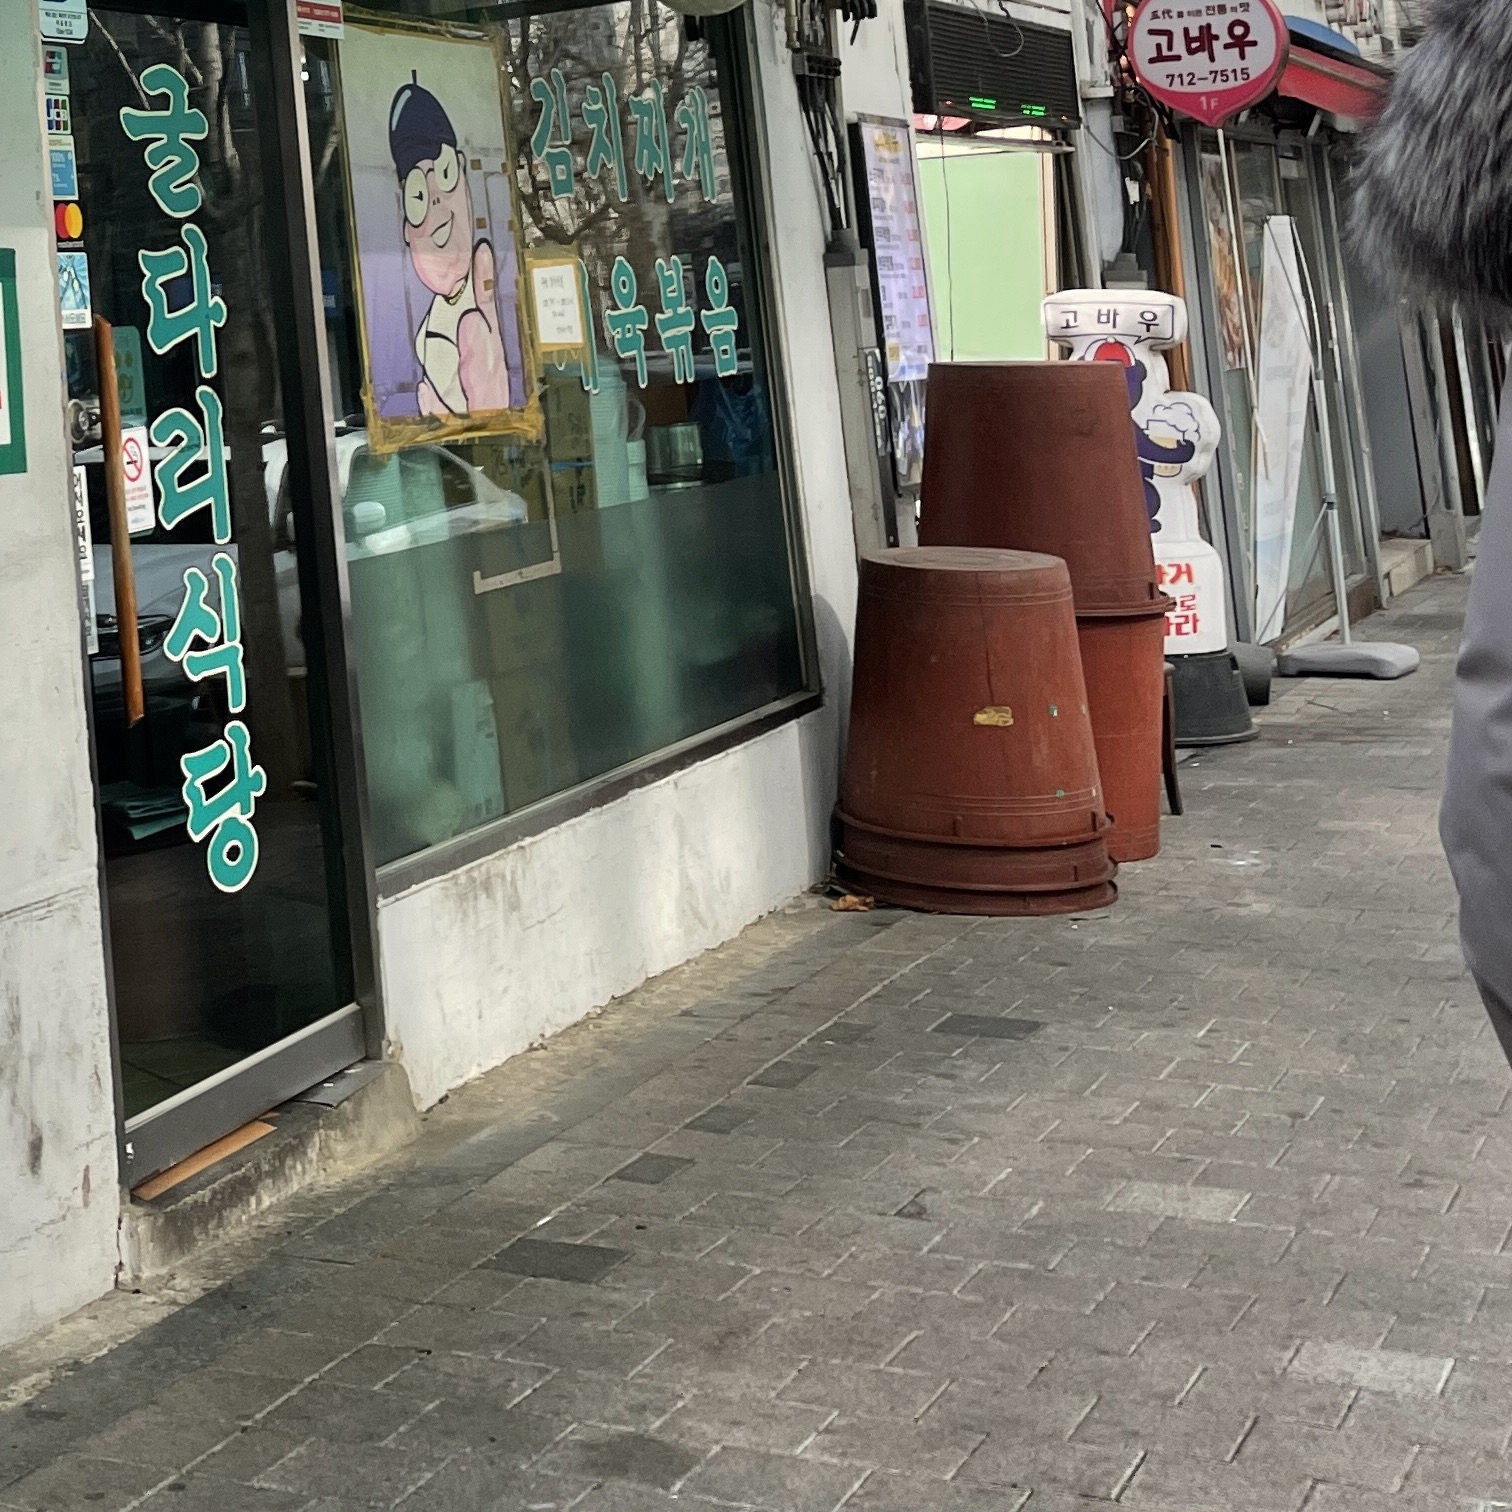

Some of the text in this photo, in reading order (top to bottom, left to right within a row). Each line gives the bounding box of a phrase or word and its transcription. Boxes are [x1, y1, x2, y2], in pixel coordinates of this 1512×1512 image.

[1148, 19, 1258, 64] 고바우
[1165, 67, 1251, 88] 712-7515
[1199, 96, 1220, 110] 1F
[530, 68, 718, 204] 김치찌개
[573, 255, 738, 394] 육볶음
[1060, 308, 1160, 333] 고바우
[120, 61, 268, 894] 굴다리식당
